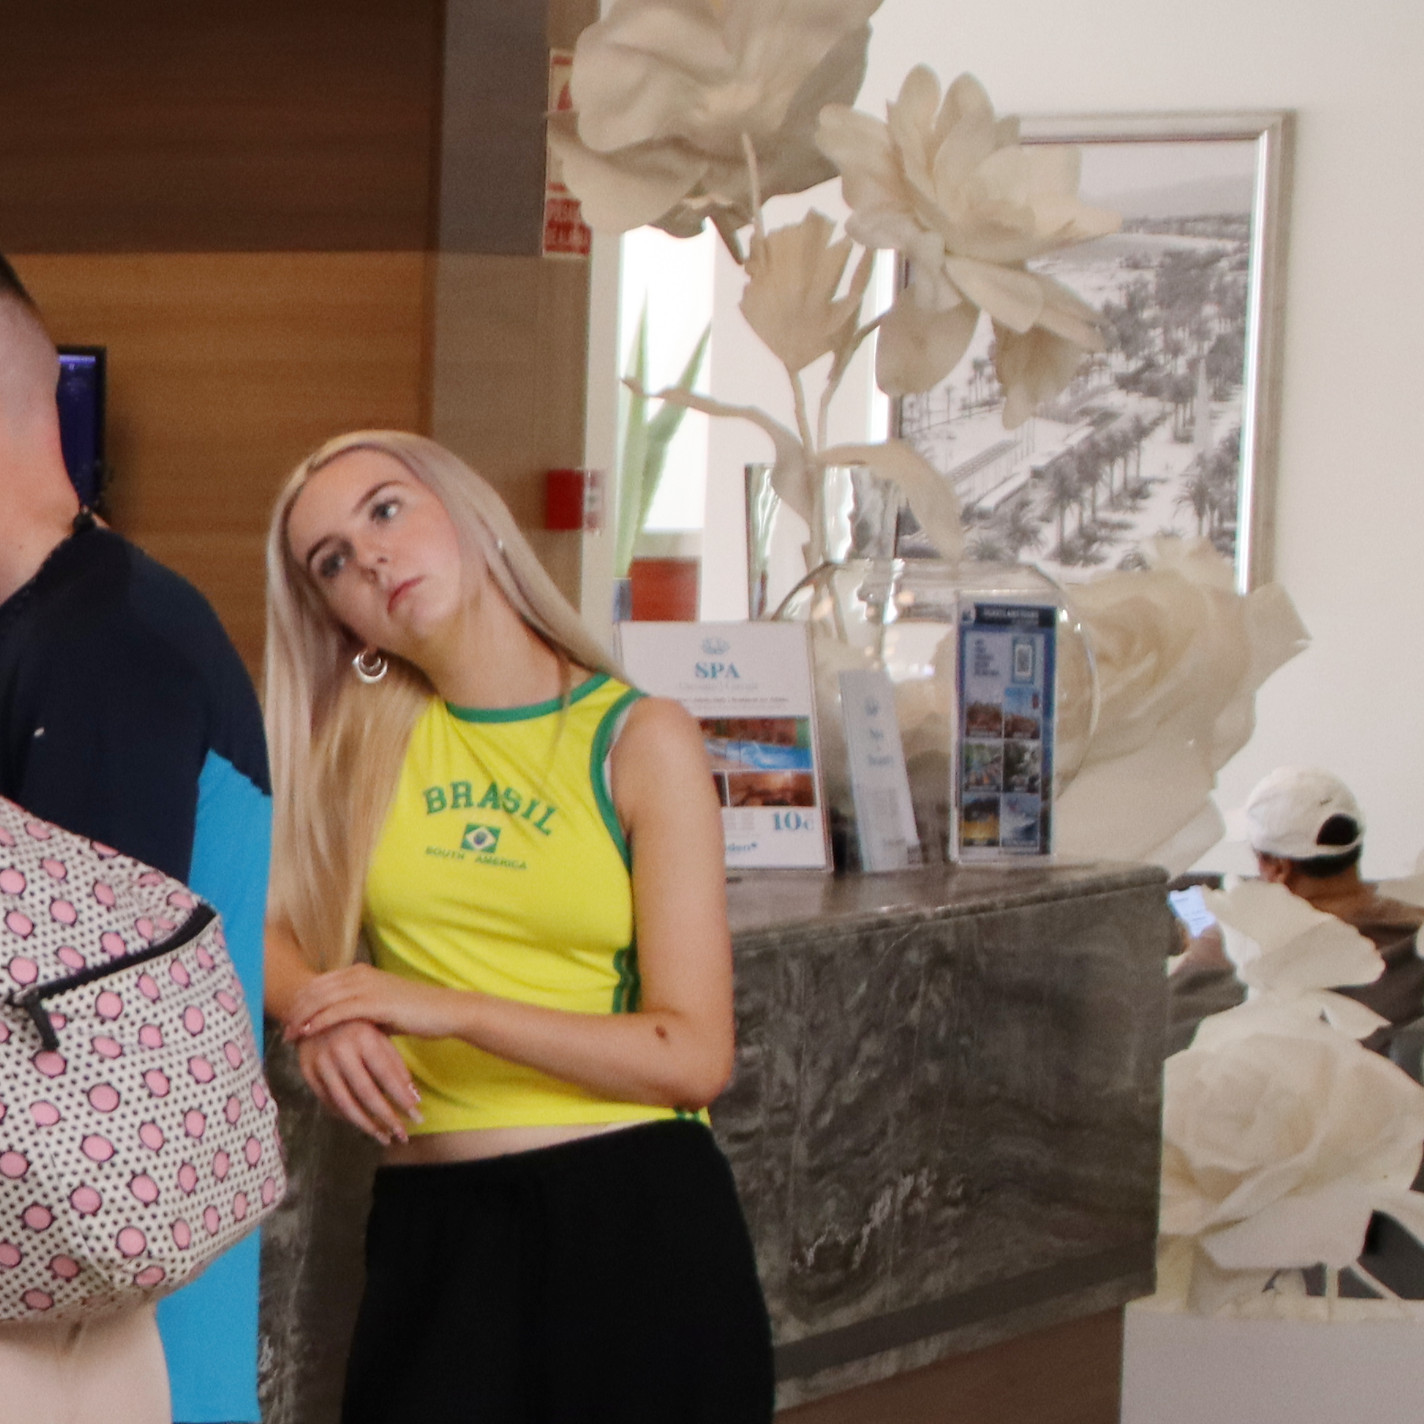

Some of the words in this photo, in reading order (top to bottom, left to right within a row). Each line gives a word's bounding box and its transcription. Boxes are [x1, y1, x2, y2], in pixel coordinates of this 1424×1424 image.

[694, 661, 740, 679] SPA
[424, 780, 558, 836] BRASIL
[425, 846, 465, 860] SOUTH
[474, 854, 527, 870] AMERICA
